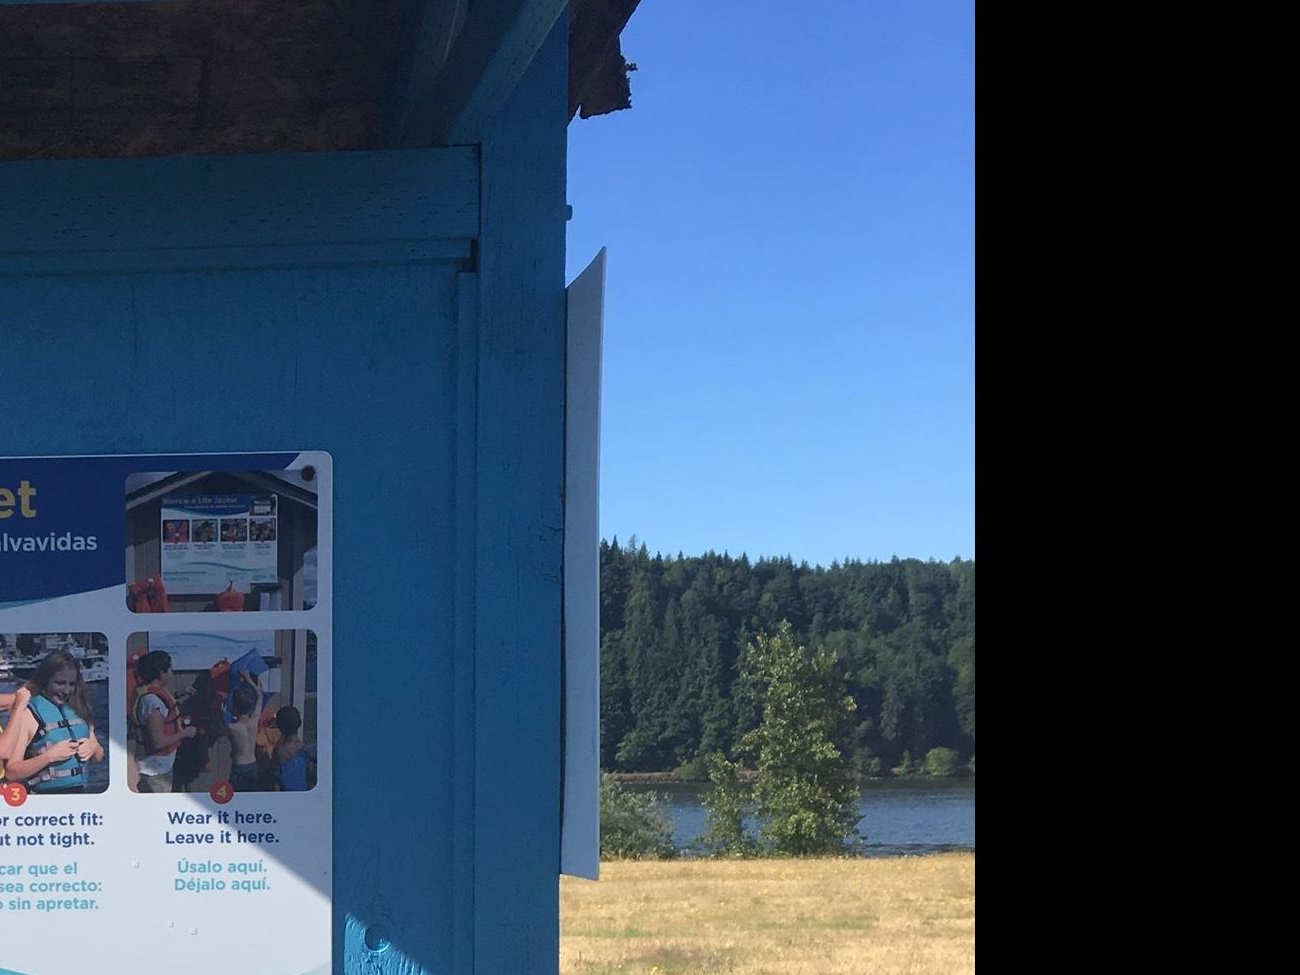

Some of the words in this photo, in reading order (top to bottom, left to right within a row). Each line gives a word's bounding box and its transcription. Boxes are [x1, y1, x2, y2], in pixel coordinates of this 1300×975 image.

[10, 788, 21, 801] 3
[215, 787, 227, 799] 4
[15, 814, 74, 826] correct
[80, 812, 103, 825] fit:
[167, 812, 213, 825] Wear
[218, 810, 230, 825] it
[234, 810, 277, 824] here.
[17, 834, 44, 846] not
[50, 832, 94, 848] tight.
[166, 832, 214, 844] Leave
[220, 830, 232, 844] it
[237, 830, 280, 844] here.
[28, 865, 58, 877] que
[64, 862, 77, 874] el
[177, 857, 222, 874] Úsalo
[227, 859, 268, 876] aquí.
[30, 879, 102, 893] correcto:
[175, 878, 225, 893] Déjalo
[231, 877, 270, 892] aquí.
[9, 897, 31, 910] sin
[36, 898, 99, 912] apretar.
